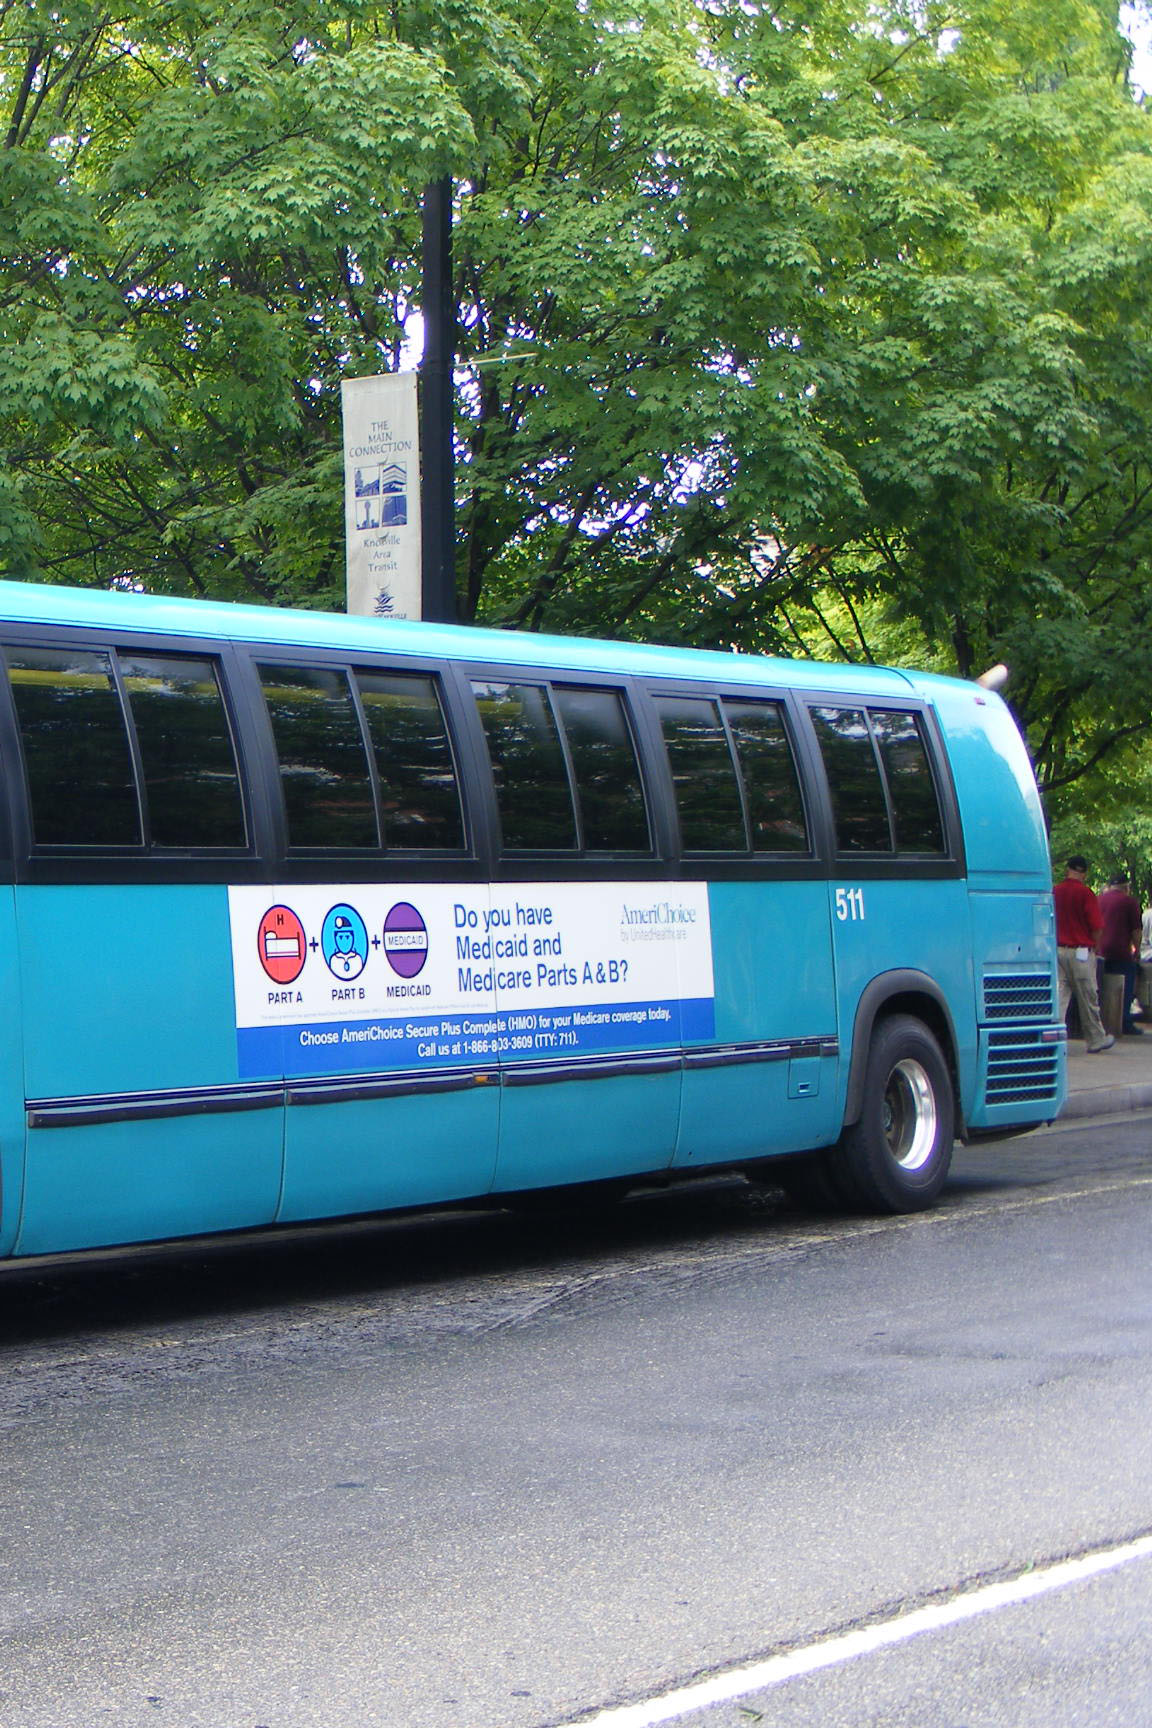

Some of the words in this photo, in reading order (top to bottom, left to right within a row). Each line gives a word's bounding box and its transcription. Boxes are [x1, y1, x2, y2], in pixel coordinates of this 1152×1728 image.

[371, 420, 390, 432] THE
[368, 431, 393, 444] MAIN
[349, 440, 412, 458] CONNECTION
[368, 561, 398, 572] Transit
[836, 888, 865, 920] 511
[276, 914, 284, 926] H
[454, 904, 478, 928] Do
[482, 909, 511, 933] you
[516, 902, 552, 925] have
[621, 902, 696, 925] AmeriChoice
[388, 935, 424, 946] MEDICAID
[533, 932, 562, 955] and
[458, 967, 532, 992] Medicare
[537, 962, 577, 987] Parts
[582, 961, 594, 984] A
[596, 962, 606, 983] &
[609, 960, 628, 982] B?
[268, 992, 293, 1004] PART
[296, 991, 303, 1002] A
[331, 988, 355, 1000] PART
[358, 988, 365, 999] B
[386, 985, 431, 997] MEDICAID
[300, 1031, 339, 1046] Choose
[342, 1026, 404, 1042] AmeriChoice
[406, 1024, 439, 1038] Secure
[441, 1022, 461, 1035] Plus
[463, 1018, 506, 1036] Complete
[508, 1015, 536, 1031] (HMO)
[539, 1016, 551, 1027] for
[553, 1016, 571, 1029] your
[574, 1011, 610, 1025] Medicare
[612, 1010, 647, 1023] coverage
[648, 1008, 671, 1021] today.
[418, 1043, 436, 1057] Call
[438, 1045, 449, 1055] us
[452, 1043, 461, 1054] at
[463, 1036, 533, 1054] 1-866-803-3609
[535, 1034, 557, 1049] (TTY:
[559, 1031, 579, 1046] 711).
